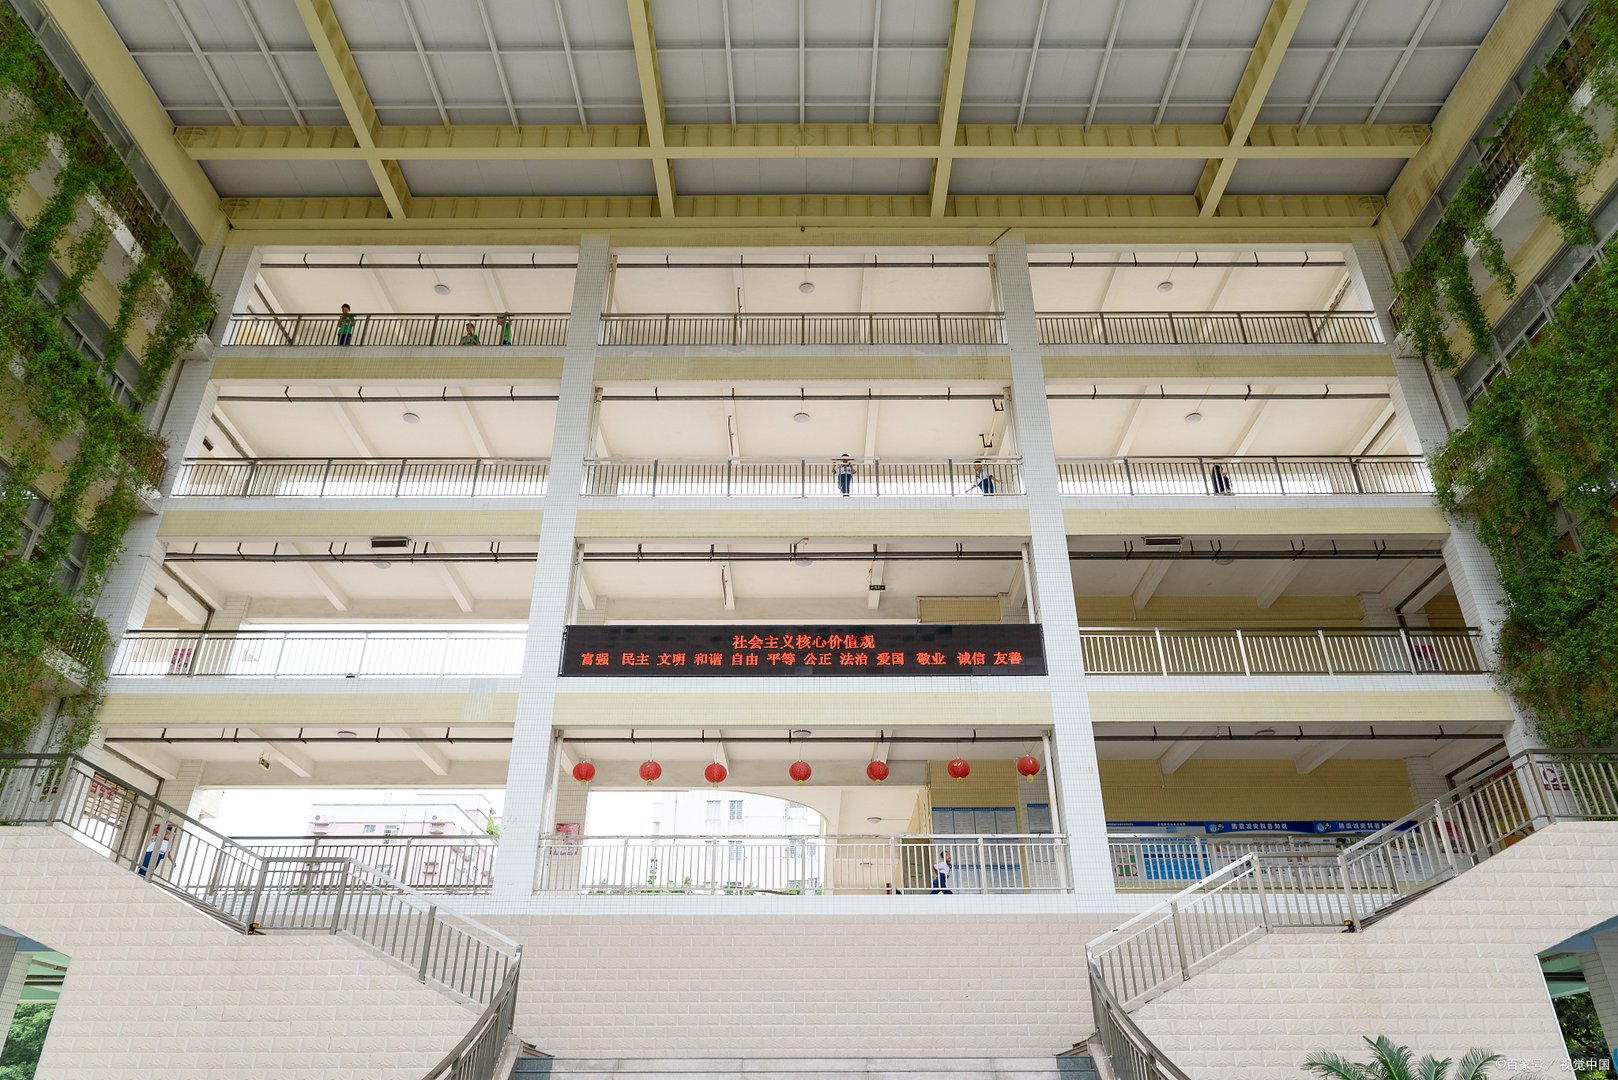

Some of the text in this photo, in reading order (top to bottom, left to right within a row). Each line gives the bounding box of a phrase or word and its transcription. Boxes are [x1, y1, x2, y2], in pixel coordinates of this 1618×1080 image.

[732, 634, 876, 650] 社会主义核心价值观
[582, 651, 1023, 666] 富强 民主 文明 和谐 自由 平等 公正 法治 爱国 敬业 诚信 友善
